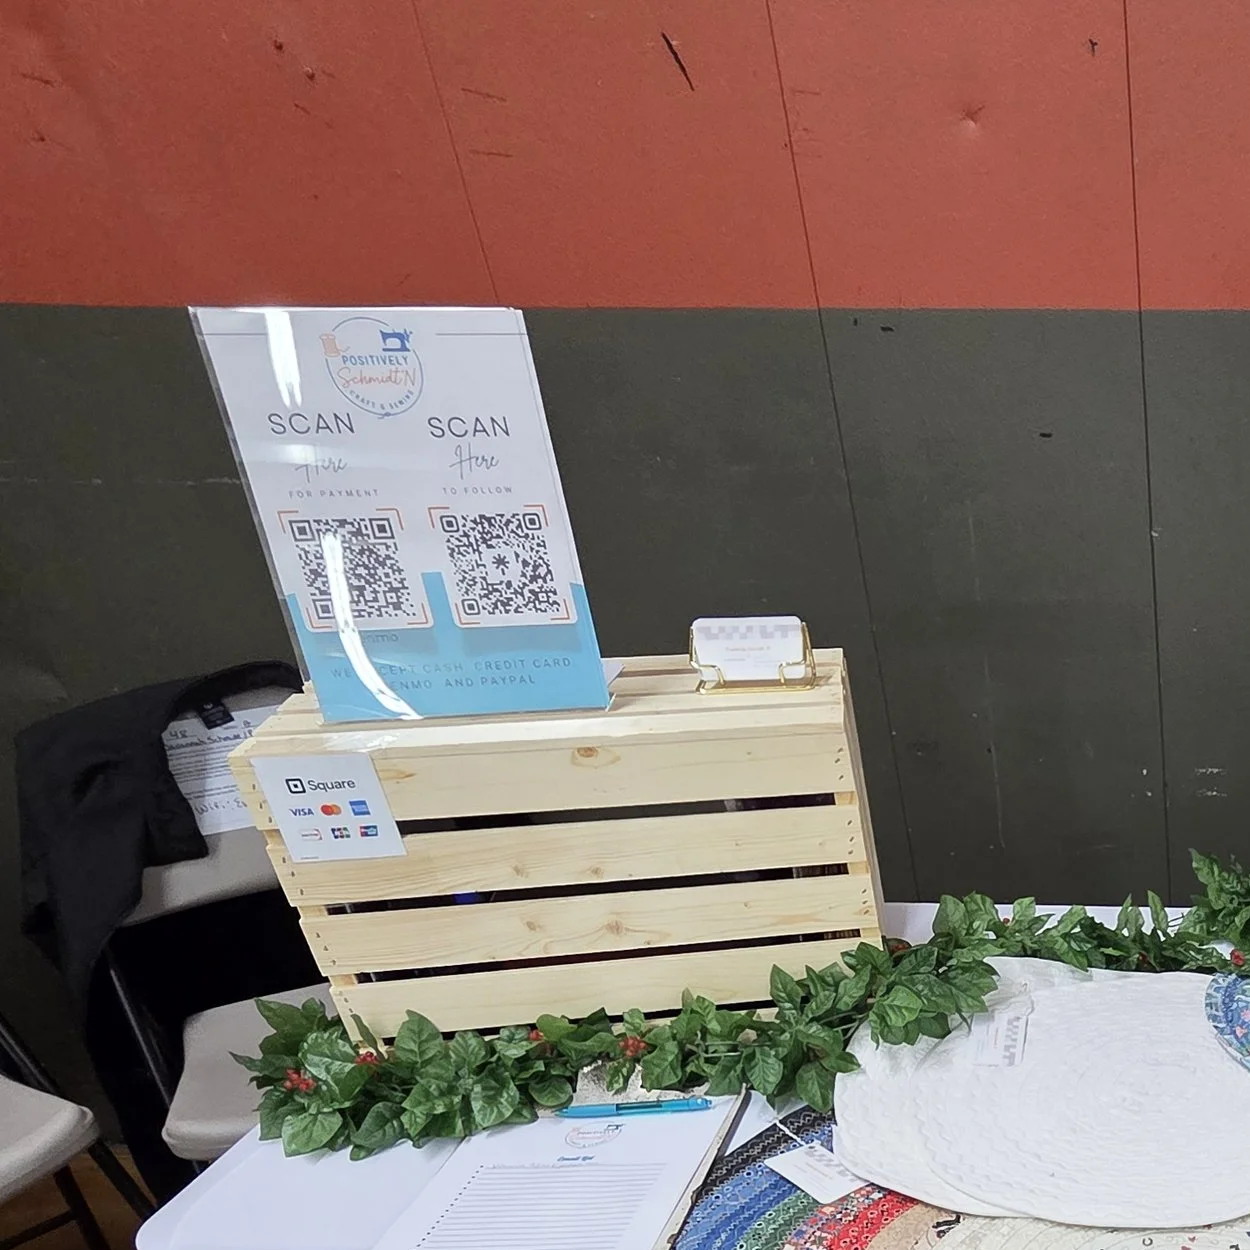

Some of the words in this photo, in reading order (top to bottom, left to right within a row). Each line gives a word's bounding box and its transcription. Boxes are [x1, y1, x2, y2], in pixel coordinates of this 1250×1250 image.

[341, 354, 408, 367] POSITIVELY
[267, 412, 356, 436] SCAN
[427, 415, 511, 438] SCAN
[449, 442, 500, 481] Here
[288, 490, 314, 500] FOR
[319, 488, 380, 498] PAYMENT
[442, 487, 458, 496] TO
[463, 486, 514, 495] FOLLOW
[474, 658, 526, 672] CREDIT
[532, 656, 573, 669] CARD
[389, 679, 432, 692] ENMO
[444, 675, 475, 688] AND
[480, 672, 536, 687] PAYPAL
[307, 778, 357, 792] Square
[288, 807, 315, 817] VISA
